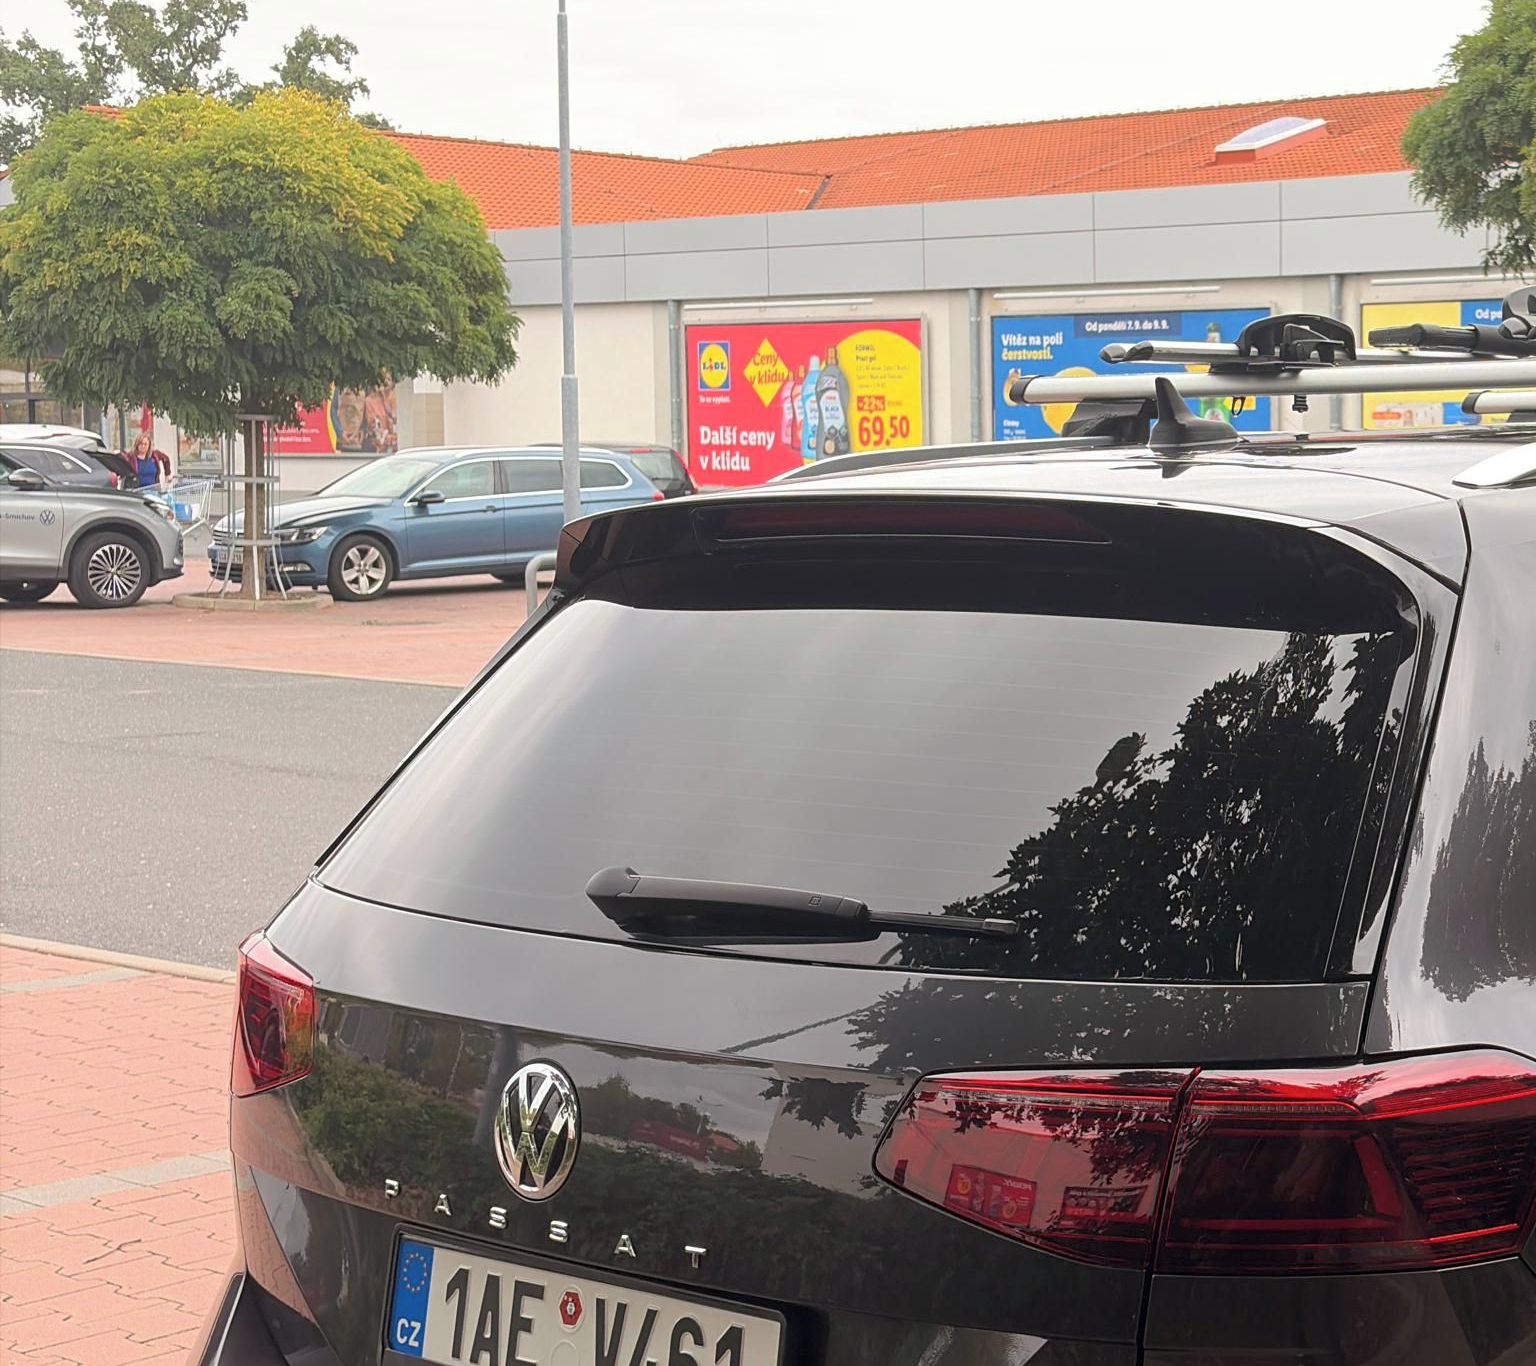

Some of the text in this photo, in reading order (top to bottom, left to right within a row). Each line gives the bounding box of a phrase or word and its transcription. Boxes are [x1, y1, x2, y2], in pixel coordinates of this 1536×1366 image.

[1475, 308, 1490, 319] Od
[1085, 321, 1098, 331] Od
[1001, 332, 1063, 347] Vítěz na poli
[753, 353, 778, 367] Ceny
[1002, 348, 1053, 360] čerstvosti.
[702, 358, 726, 371] LIDL
[758, 368, 784, 385] klidu
[700, 426, 775, 451] Další ceny
[700, 450, 750, 471] v klidu
[385, 1179, 707, 1269] PASSAT
[396, 1317, 420, 1348] CZ
